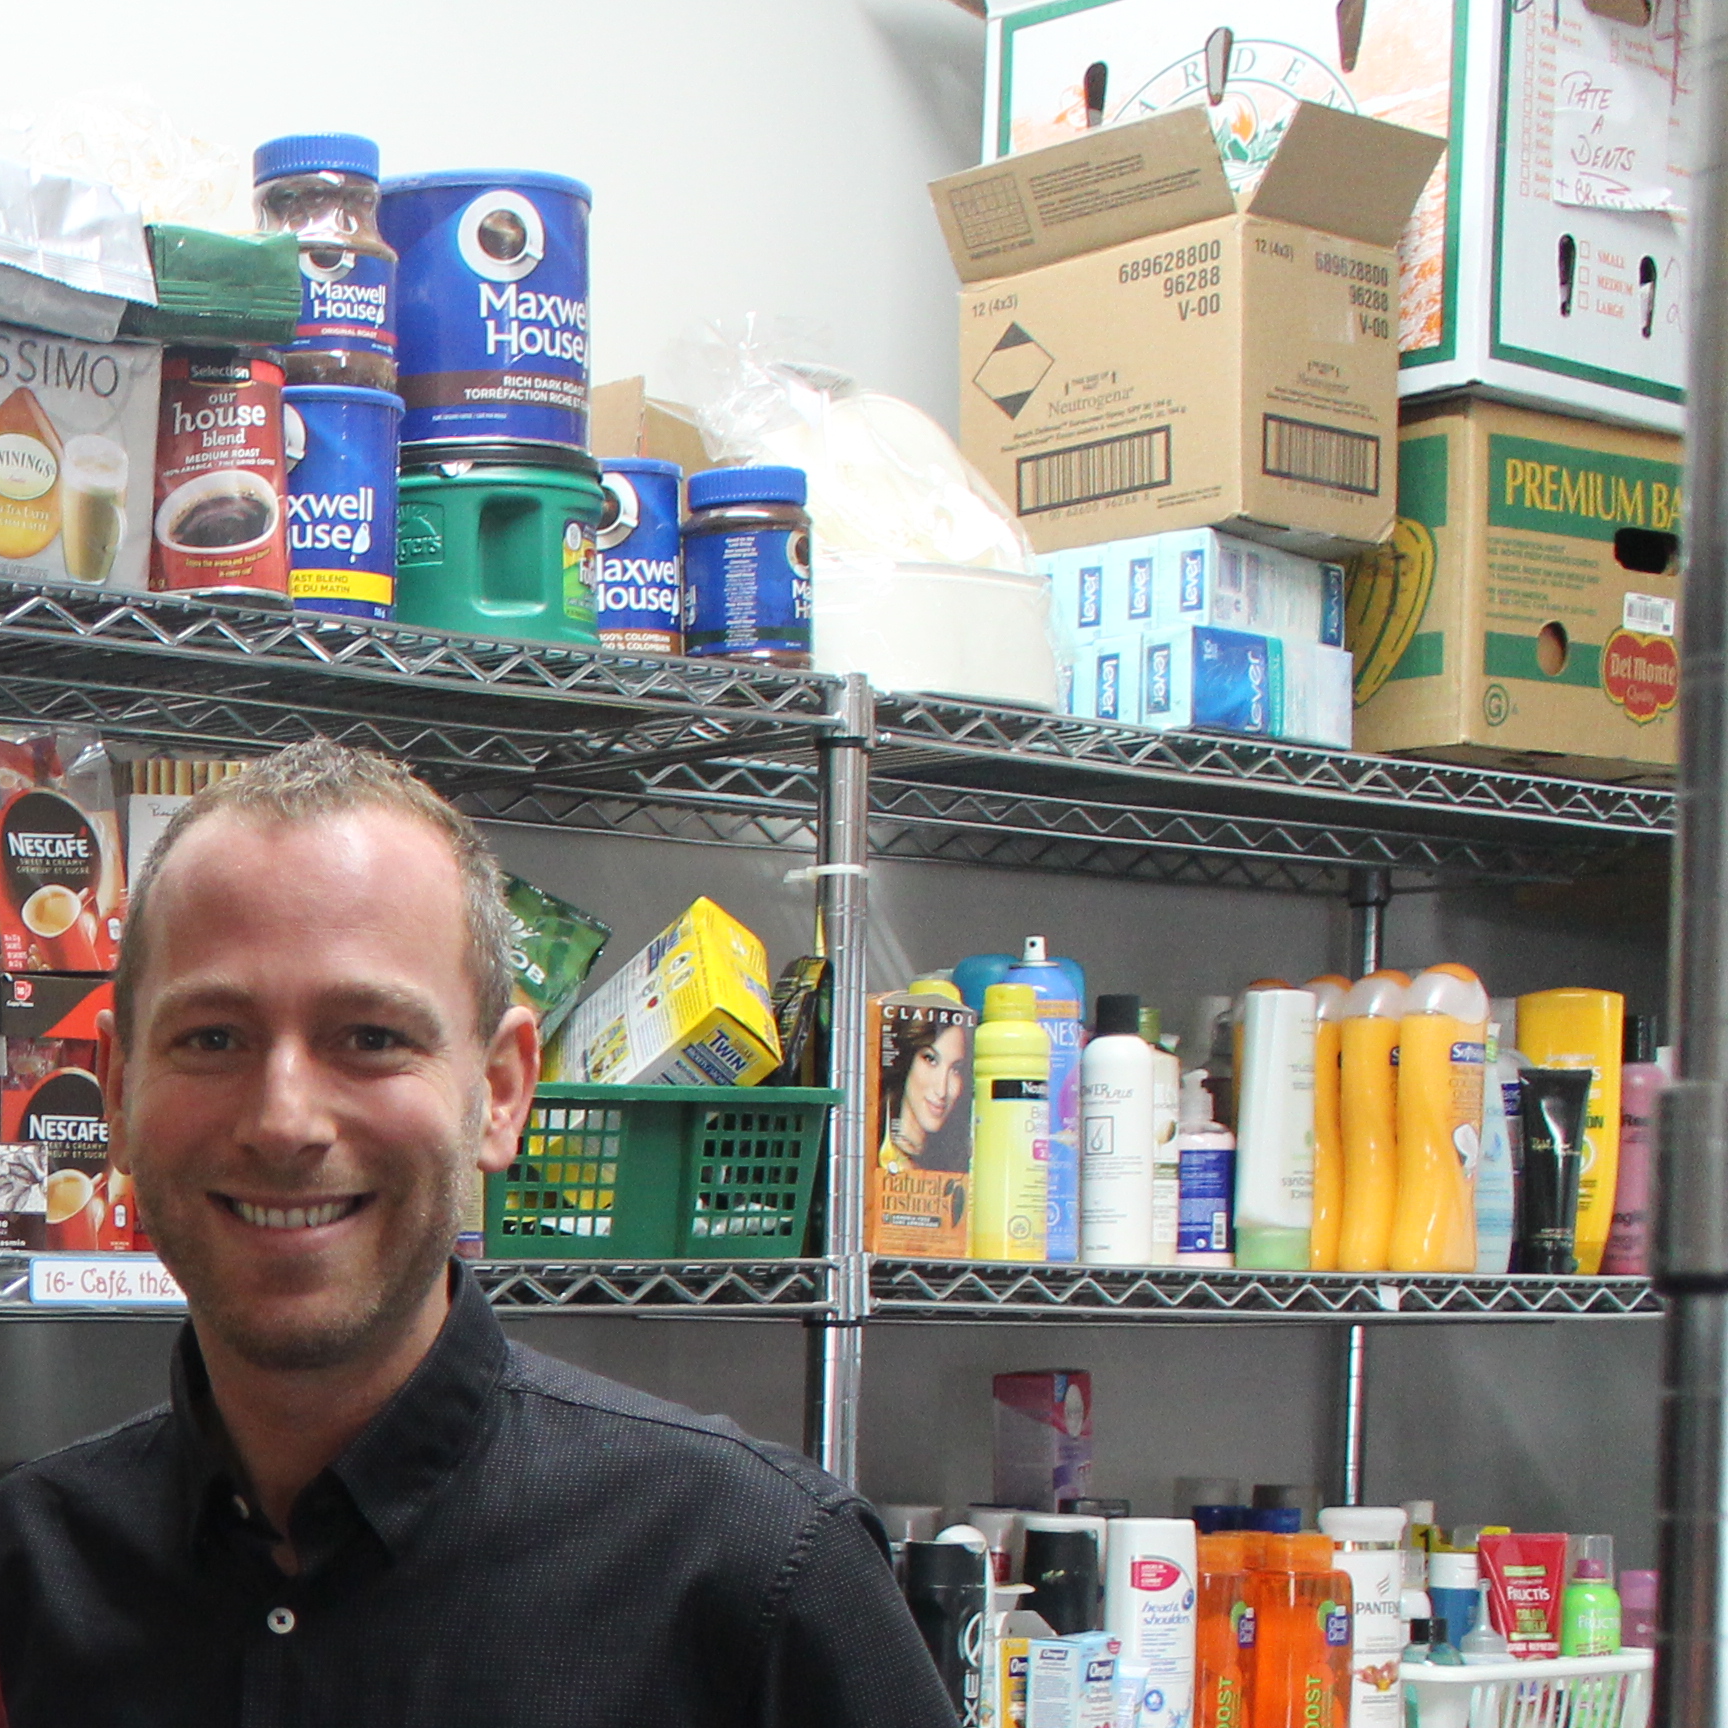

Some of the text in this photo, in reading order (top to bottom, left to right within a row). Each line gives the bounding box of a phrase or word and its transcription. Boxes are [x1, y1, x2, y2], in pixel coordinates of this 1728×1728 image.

[1571, 135, 1636, 172] DENTS
[1255, 238, 1266, 253] 12
[1118, 239, 1221, 285] 689628800
[1315, 251, 1388, 287] 689628800
[1598, 251, 1625, 269] SMALL
[1162, 265, 1220, 298] 96288
[1597, 275, 1633, 296] MEDIUM
[310, 280, 386, 305] Maxwell
[1348, 285, 1389, 312] 96288
[313, 299, 376, 322] House
[972, 303, 986, 318] 12
[1178, 293, 1220, 322] V-00
[1596, 299, 1624, 319] LARGE
[1359, 313, 1388, 339] V-00
[486, 320, 585, 364] House
[191, 364, 250, 379] Selection
[503, 375, 561, 391] RICH DARK
[208, 391, 236, 404] our
[464, 387, 547, 402] TORRÉFACTION
[1047, 386, 1129, 418] Neutrogena
[173, 402, 266, 435] house
[202, 431, 246, 448] blend
[185, 448, 260, 465] MEDIUM ROAST
[1505, 458, 1644, 525] PREMIUM
[883, 1005, 976, 1027] CLAIROL
[882, 1172, 942, 1193] natural
[882, 1193, 951, 1212] instincts
[44, 1270, 74, 1294] 16-
[80, 1269, 133, 1304] Café,
[1507, 1586, 1550, 1602] FRUCTIS
[1142, 1610, 1192, 1627] shoulders
